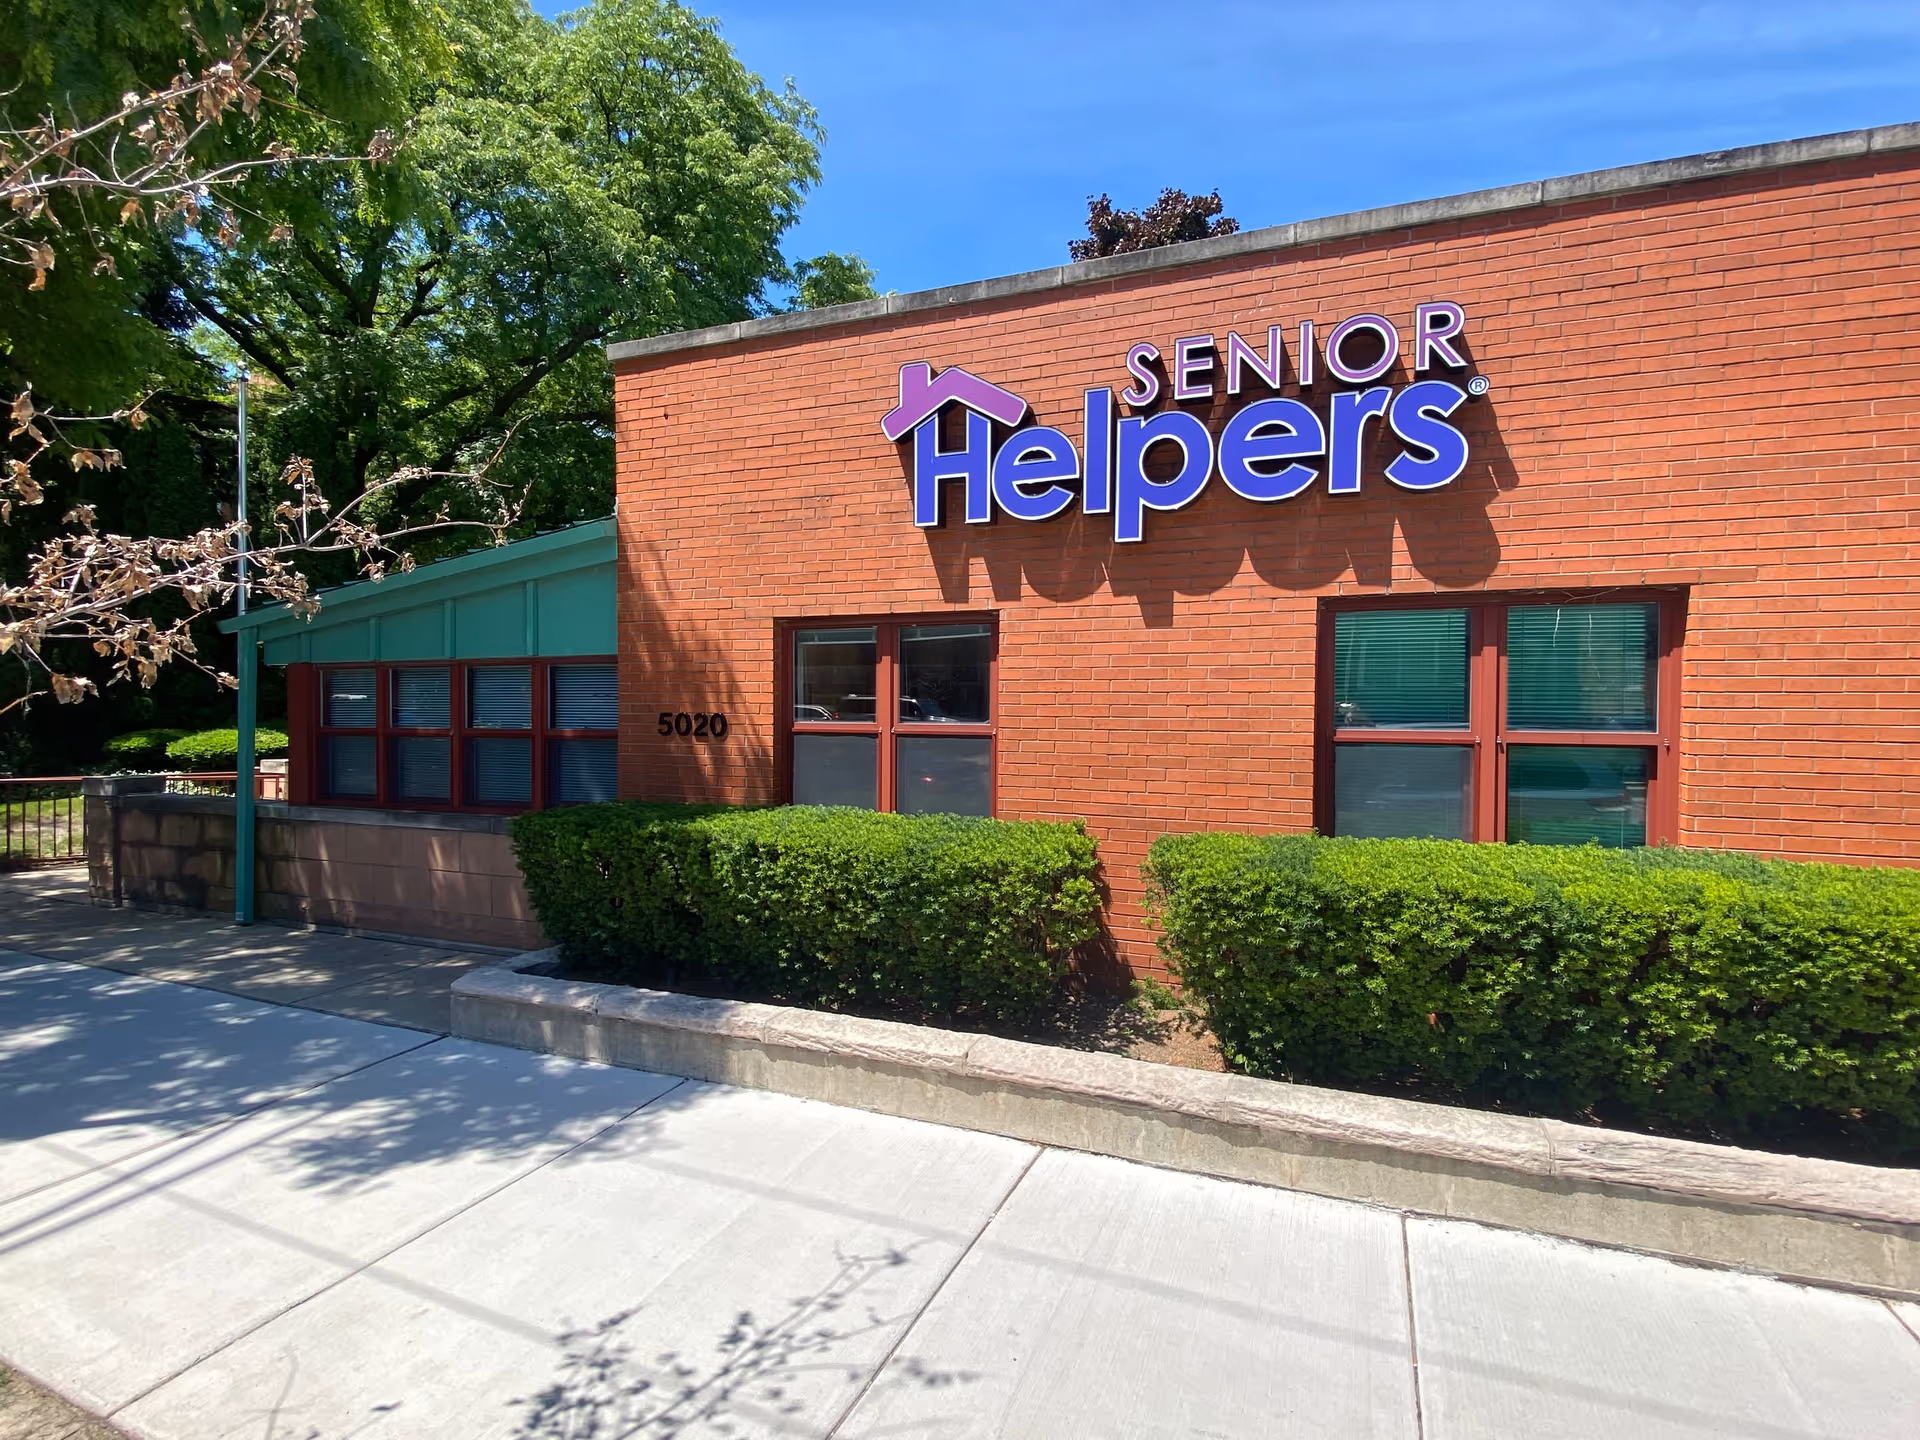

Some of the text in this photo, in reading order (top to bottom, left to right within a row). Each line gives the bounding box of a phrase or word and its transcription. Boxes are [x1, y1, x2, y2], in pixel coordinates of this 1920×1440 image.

[1121, 301, 1469, 407] SENIOR
[914, 380, 1470, 543] Helpers
[657, 711, 728, 737] 5020
